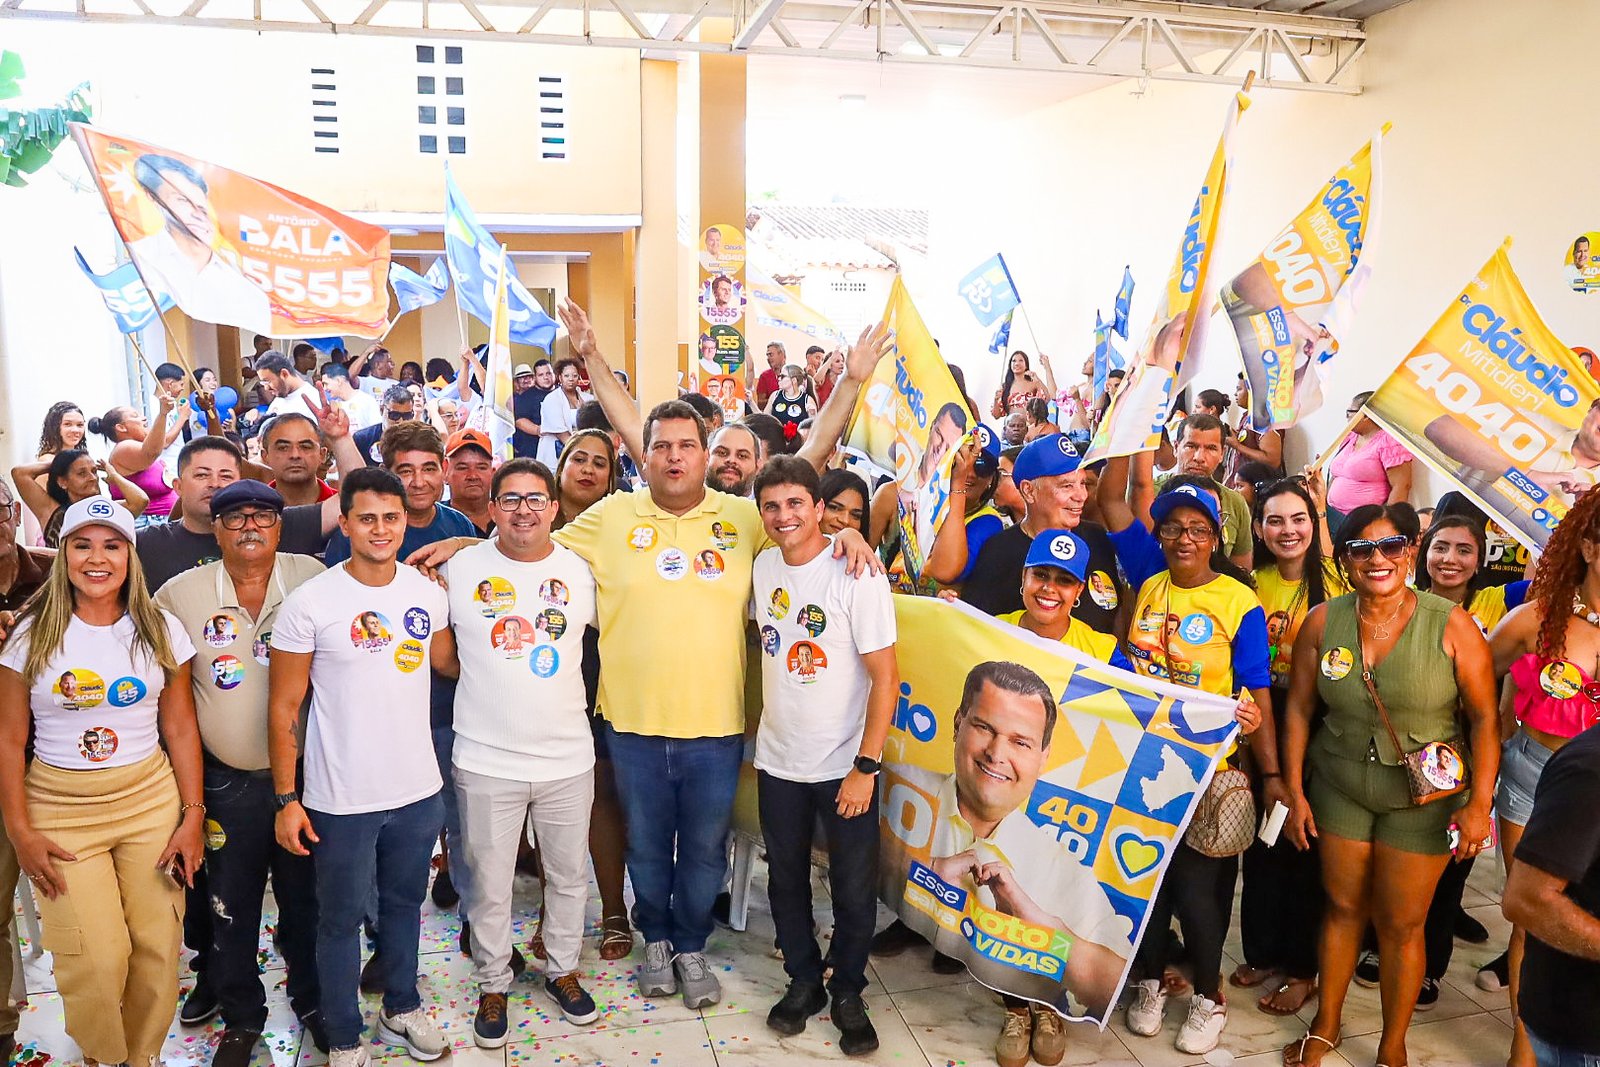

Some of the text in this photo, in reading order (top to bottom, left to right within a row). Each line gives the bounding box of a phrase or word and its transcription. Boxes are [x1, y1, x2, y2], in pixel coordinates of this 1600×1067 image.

[267, 213, 320, 227] ANTÔNIO
[239, 214, 353, 257] BALA
[1262, 224, 1326, 304] 040
[1268, 308, 1287, 342] Esse
[716, 336, 740, 349] 155
[1462, 303, 1579, 408] Cláudio
[1458, 341, 1547, 411] Mitidieri
[1405, 352, 1548, 463] 4040
[1507, 471, 1543, 499] Esse
[91, 504, 110, 515] 55
[1054, 540, 1073, 555] 55
[809, 611, 824, 623] 155
[1185, 623, 1207, 637] 55
[213, 659, 238, 676] 55
[535, 656, 555, 669] 55
[117, 686, 139, 702] 55
[1037, 796, 1099, 835] 40
[913, 866, 960, 905] Esse
[975, 931, 1061, 975] VIDAS
